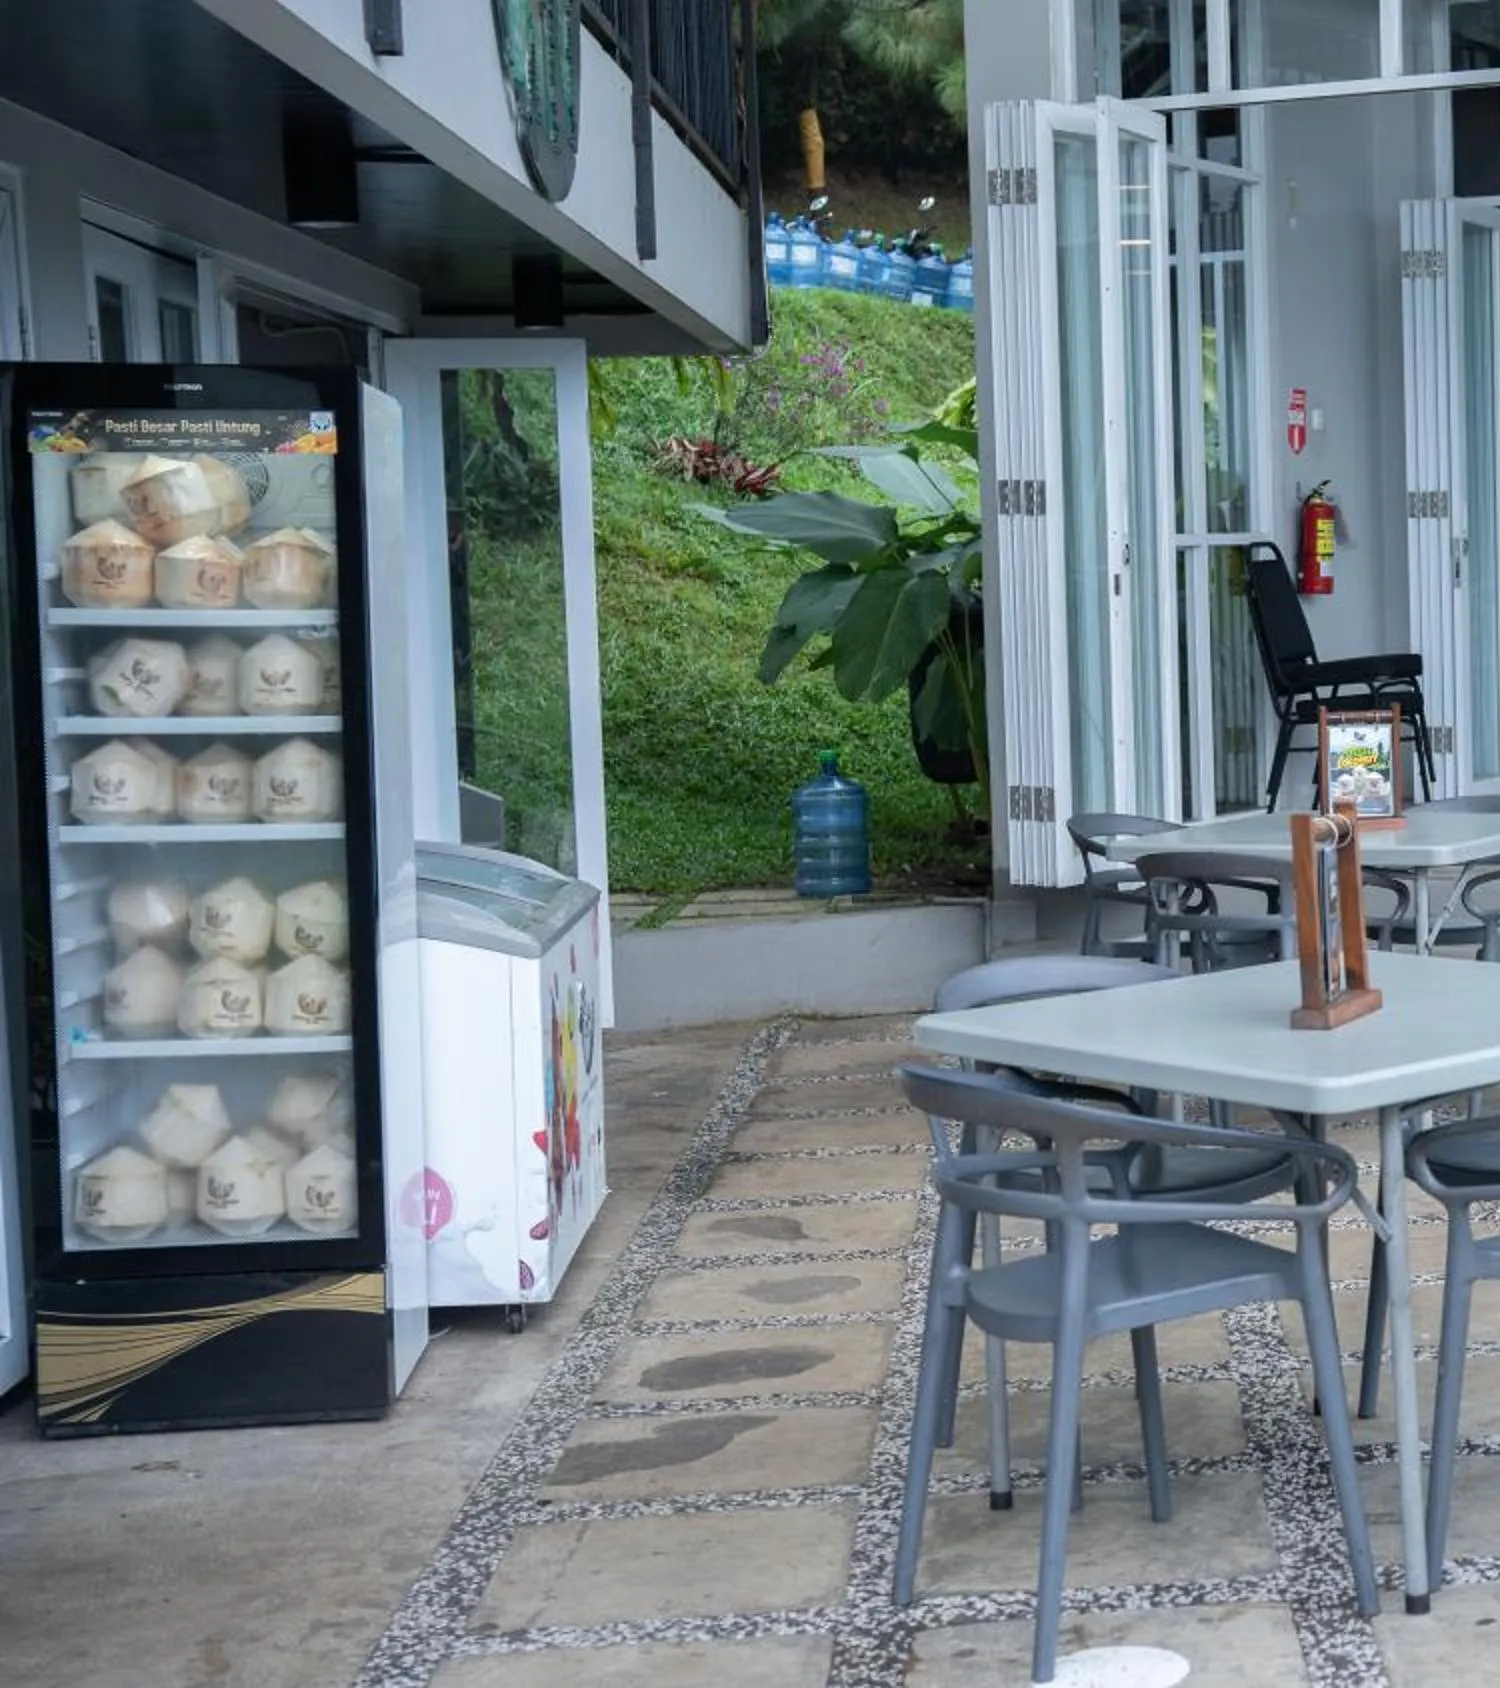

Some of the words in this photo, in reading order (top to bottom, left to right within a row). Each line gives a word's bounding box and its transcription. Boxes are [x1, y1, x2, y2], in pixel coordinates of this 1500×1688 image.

[105, 419, 138, 433] Pasti
[141, 420, 178, 433] Besar
[181, 419, 213, 433] Pasti
